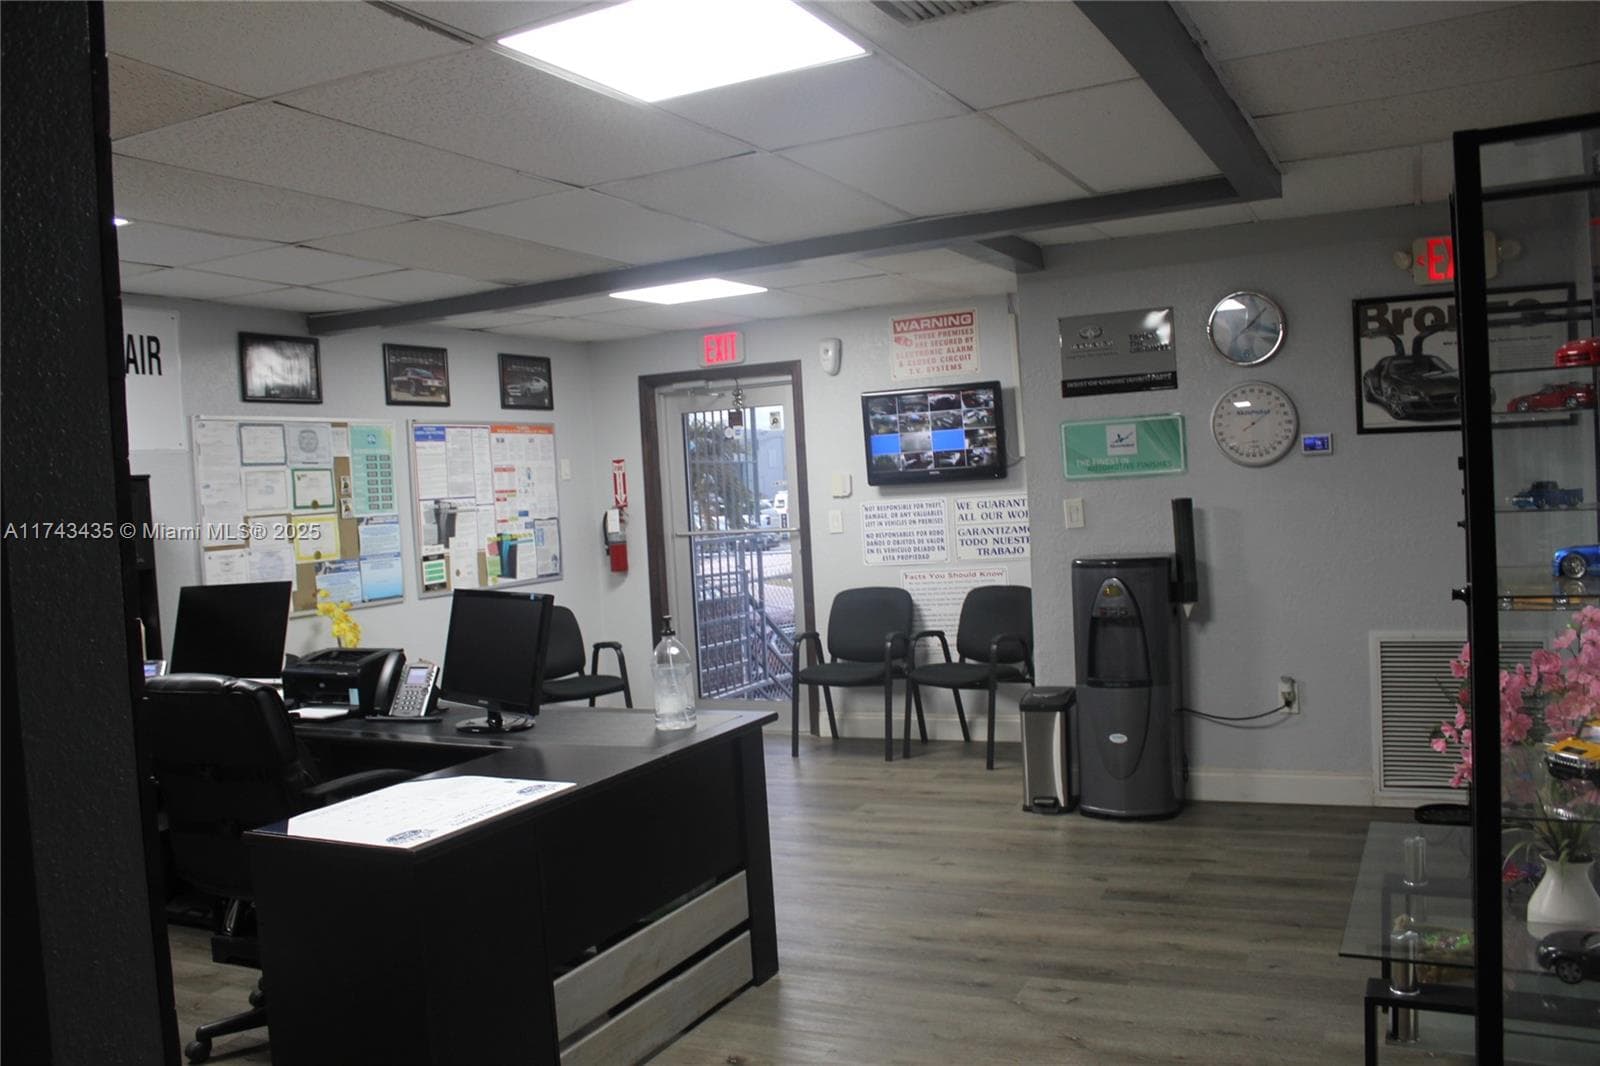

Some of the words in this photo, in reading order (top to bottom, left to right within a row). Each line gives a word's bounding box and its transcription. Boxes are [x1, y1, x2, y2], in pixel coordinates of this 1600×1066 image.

[894, 314, 973, 332] WARNING
[937, 327, 974, 339] PREMISES
[930, 337, 963, 348] SECURED
[965, 336, 974, 344] BY
[703, 331, 737, 364] EXIT
[896, 348, 942, 360] ELECTRONIC
[946, 344, 974, 354] ALARM
[125, 333, 163, 377] AIR
[907, 356, 937, 367] CLOSED
[940, 353, 972, 363] CIRCUIT
[926, 362, 963, 373] SYSTEMS
[864, 504, 875, 512] NOT
[876, 503, 912, 511] RESPONSIBLE
[956, 501, 971, 511] WE
[890, 511, 898, 519] OR
[912, 509, 943, 517] VALUABLES
[959, 512, 976, 521] ALL
[980, 511, 1003, 521] OUR
[865, 520, 876, 528] LEFT
[884, 519, 908, 527] VEHICLES
[917, 517, 943, 525] PREMISES
[875, 531, 914, 539] RESPONSABLES
[892, 538, 916, 546] OBJETOS
[960, 537, 988, 547] TODO
[913, 545, 936, 553] DEJADO
[977, 546, 1025, 556] TRABAJO
[897, 553, 930, 561] PROPIEDAD
[905, 572, 926, 580] Facts
[929, 571, 946, 579] You
[948, 569, 977, 579] Should
[979, 569, 1004, 577] Know
